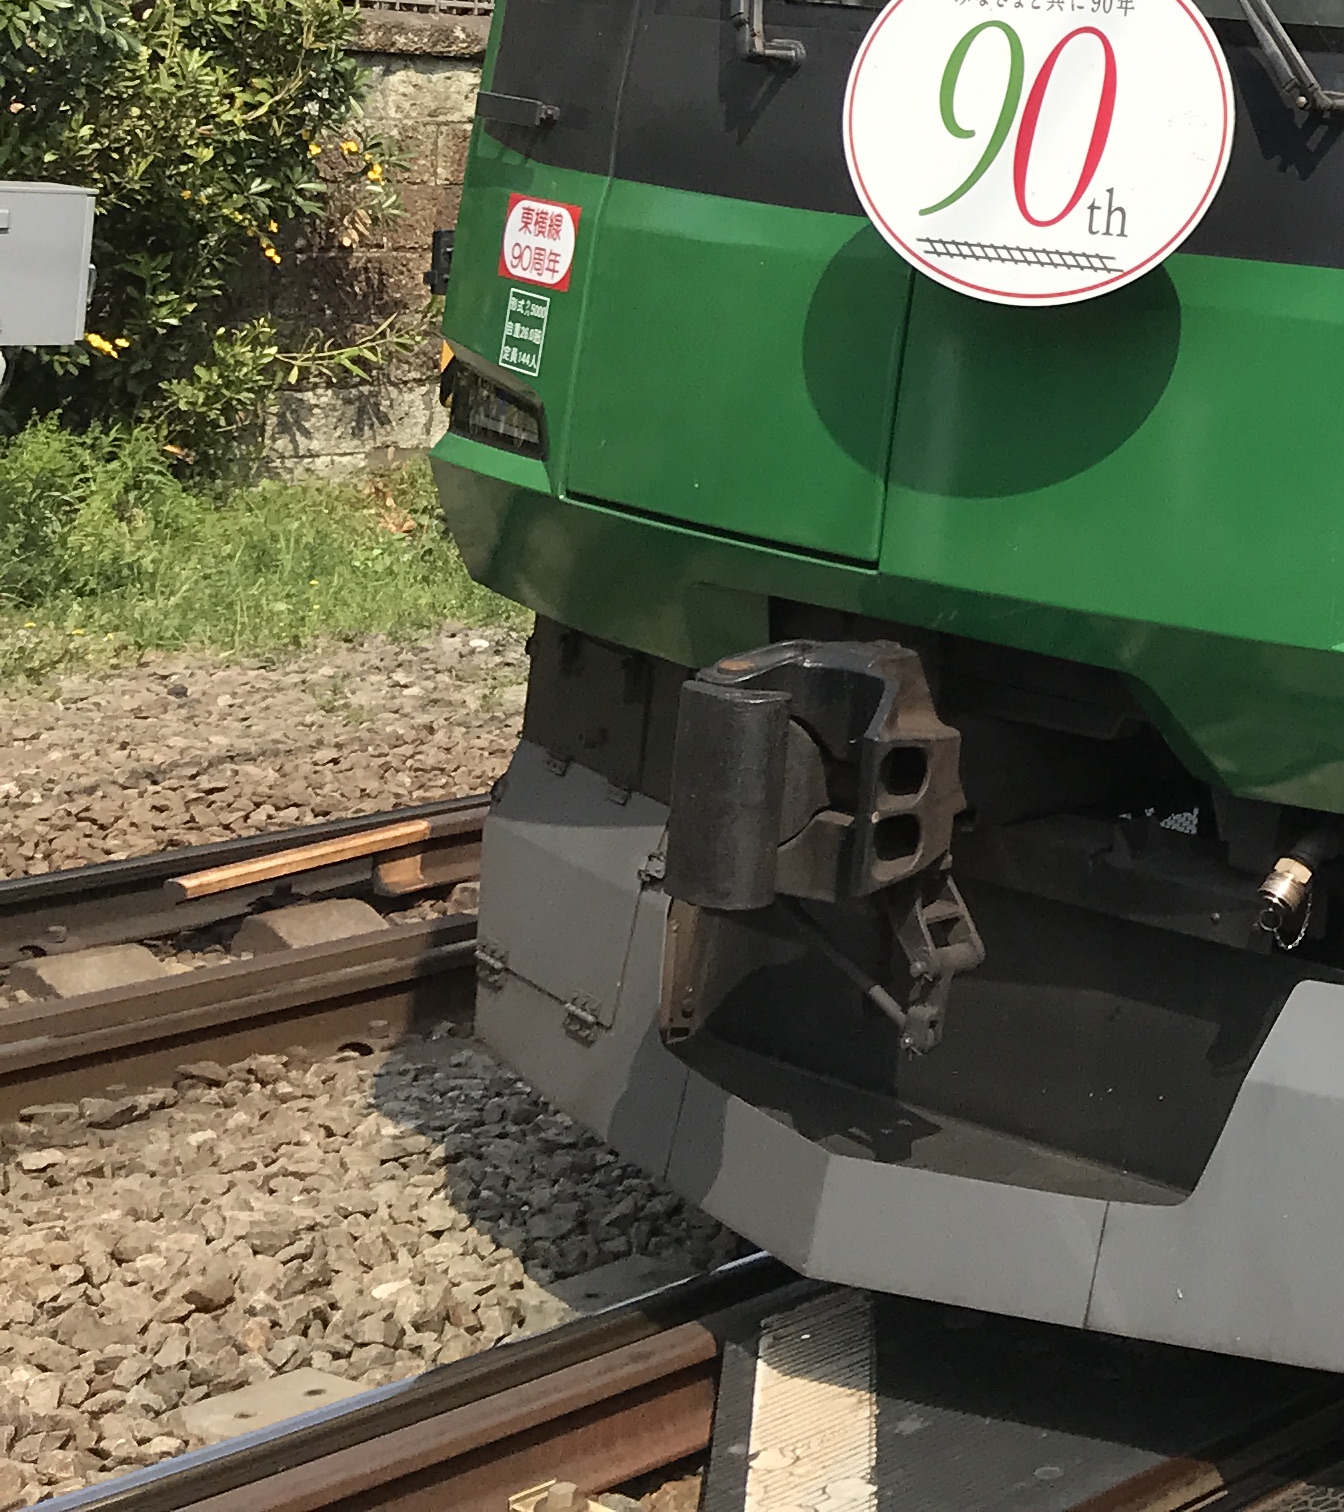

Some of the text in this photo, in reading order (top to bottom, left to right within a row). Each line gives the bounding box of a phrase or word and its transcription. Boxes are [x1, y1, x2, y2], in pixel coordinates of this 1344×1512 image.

[518, 206, 564, 242] 東横線
[510, 242, 562, 281] 90周年
